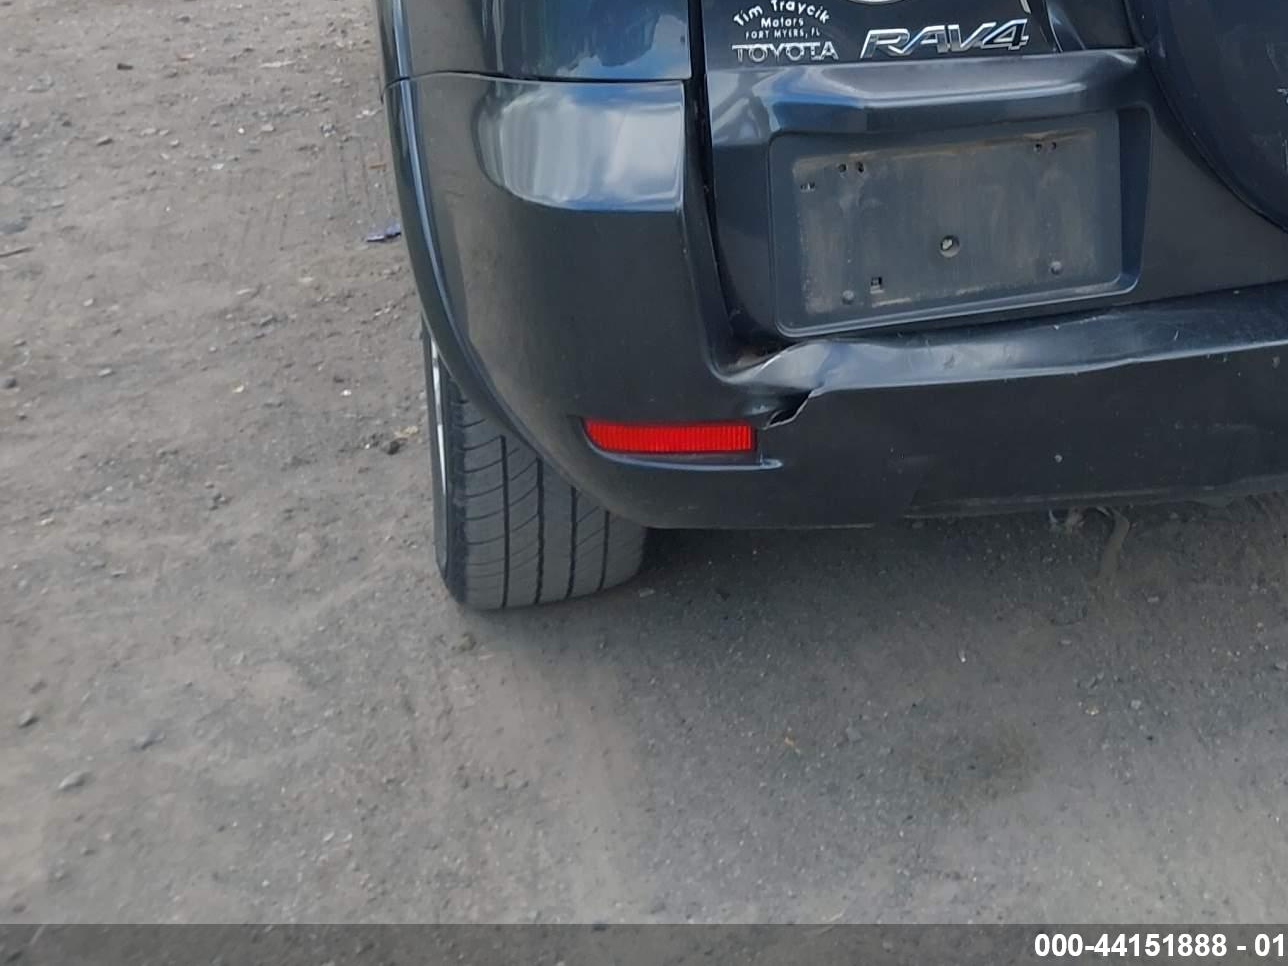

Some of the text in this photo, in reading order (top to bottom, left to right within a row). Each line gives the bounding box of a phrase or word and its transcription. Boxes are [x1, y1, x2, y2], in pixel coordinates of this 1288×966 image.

[733, 5, 763, 26] Tim
[760, 16, 805, 28] Motors
[745, 29, 770, 40] FORT
[860, 18, 1030, 59] RAV4
[731, 40, 840, 63] TOYOTA
